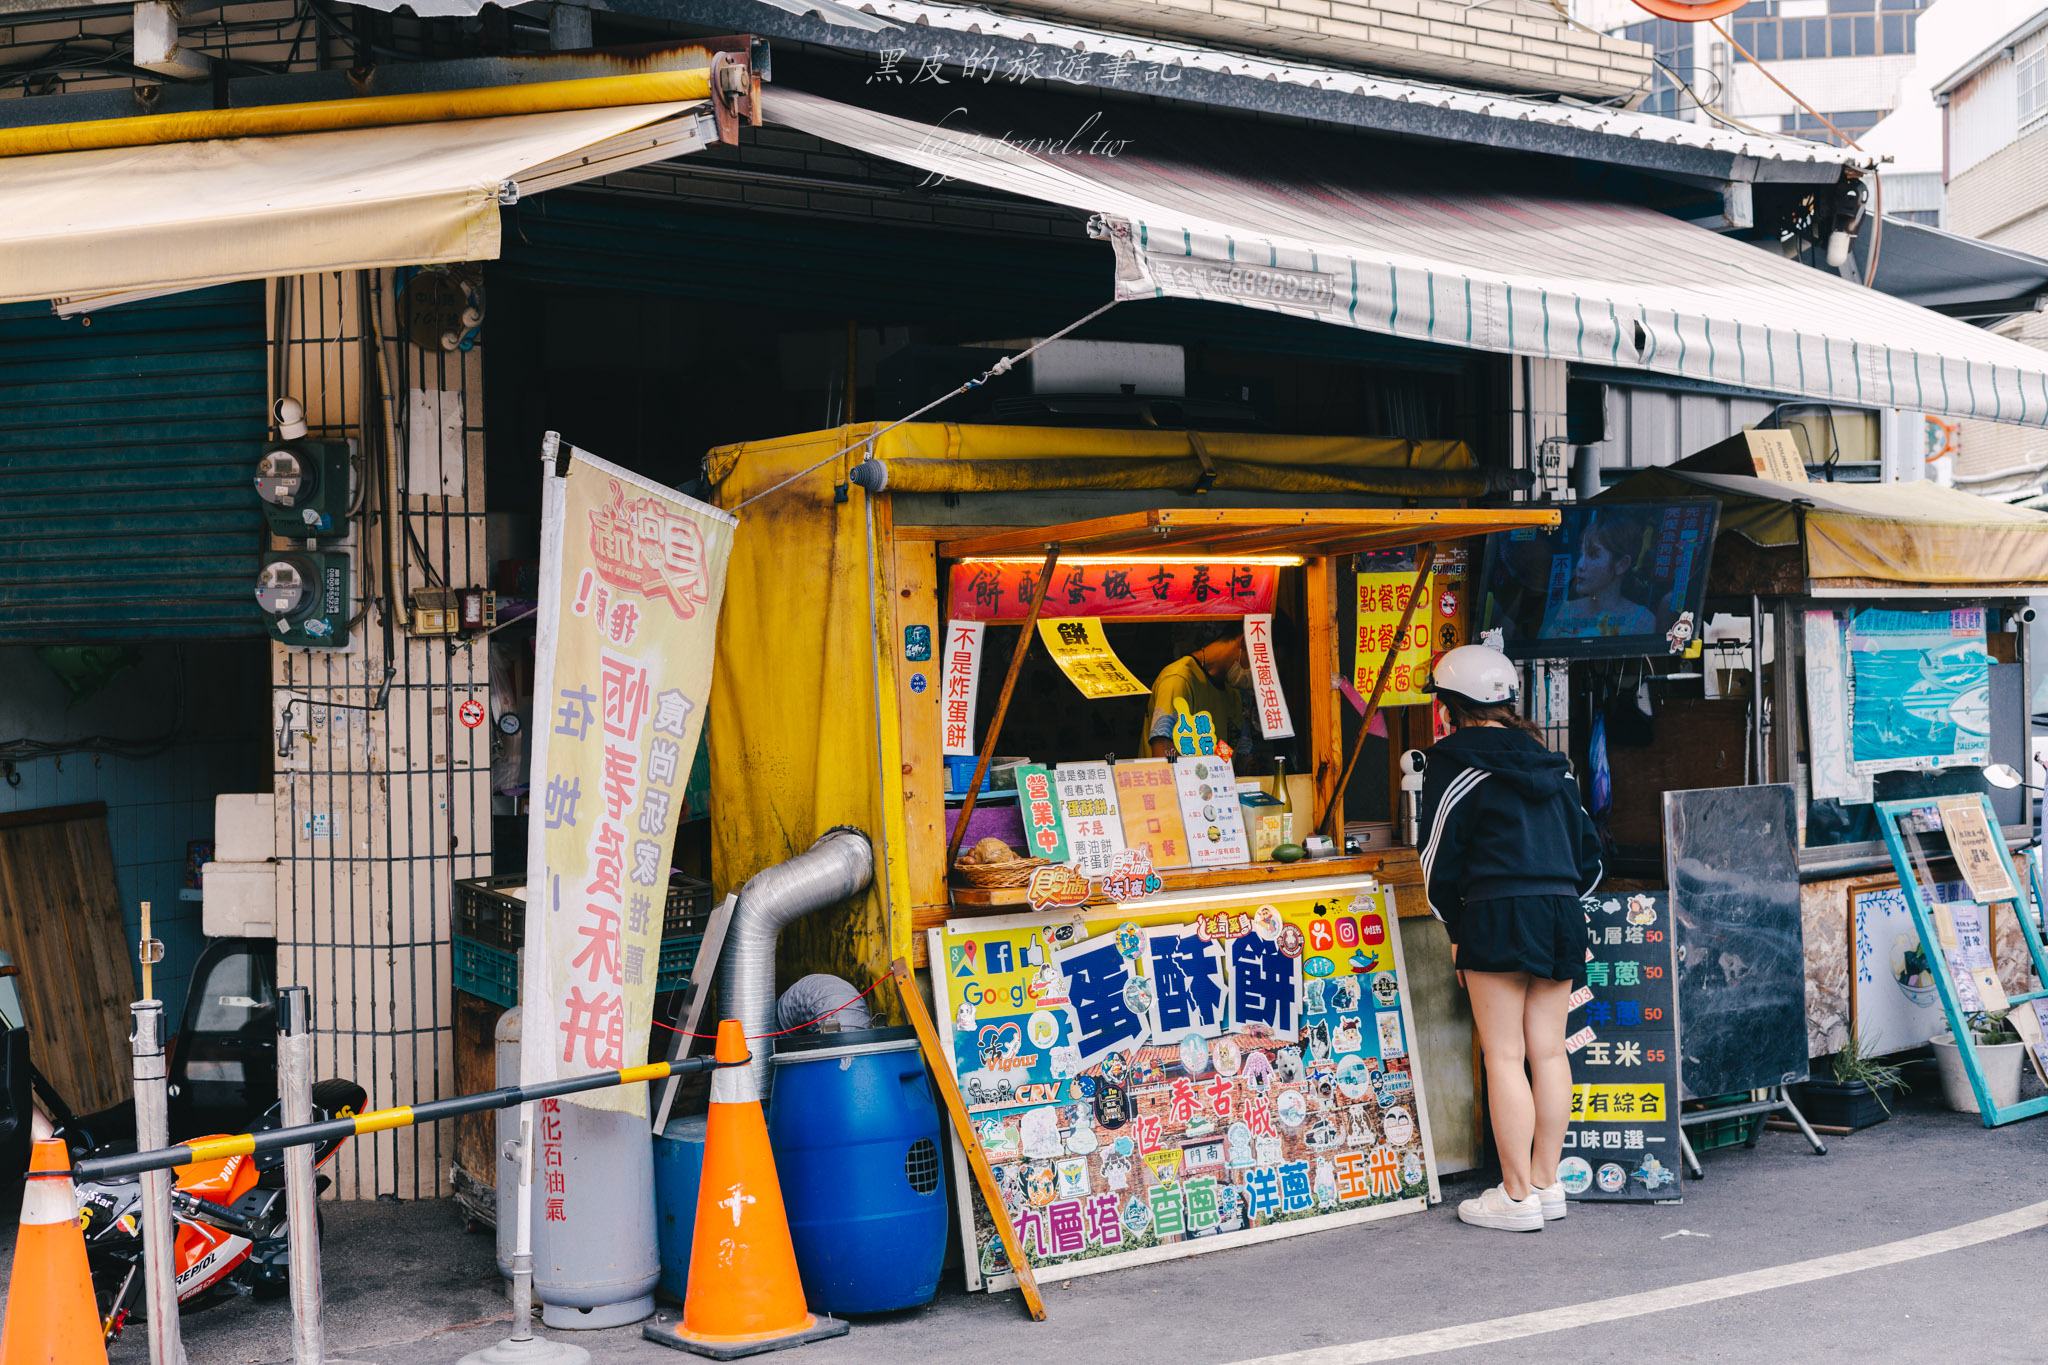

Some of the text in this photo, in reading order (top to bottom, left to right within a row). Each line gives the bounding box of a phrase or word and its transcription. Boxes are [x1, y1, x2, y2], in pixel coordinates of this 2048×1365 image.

[946, 627, 977, 749] 不是炸蛋餅
[1248, 620, 1286, 731] 不是蔥油餅
[1056, 768, 1107, 782] 這是發源自
[1026, 774, 1058, 853] 營業中
[1078, 820, 1105, 837] 不是
[1587, 926, 1663, 945] 九層塔 50
[1586, 961, 1663, 987] 青蔥 50
[964, 977, 1040, 1008] Google
[1060, 931, 1297, 1059] 蛋酥餅
[1586, 1001, 1663, 1027] 洋蔥 50
[987, 1053, 1038, 1072] Vigour
[1585, 1040, 1665, 1067] 玉米 55
[1015, 1082, 1062, 1104] CRV
[1571, 1092, 1660, 1114] 沒有綜合
[1133, 1075, 1277, 1155] 恆春古城
[1563, 1129, 1666, 1150] 口味四選一
[1336, 1149, 1401, 1200] 玉米
[1245, 1161, 1313, 1219] 洋蔥
[1014, 1194, 1123, 1256] 九層塔
